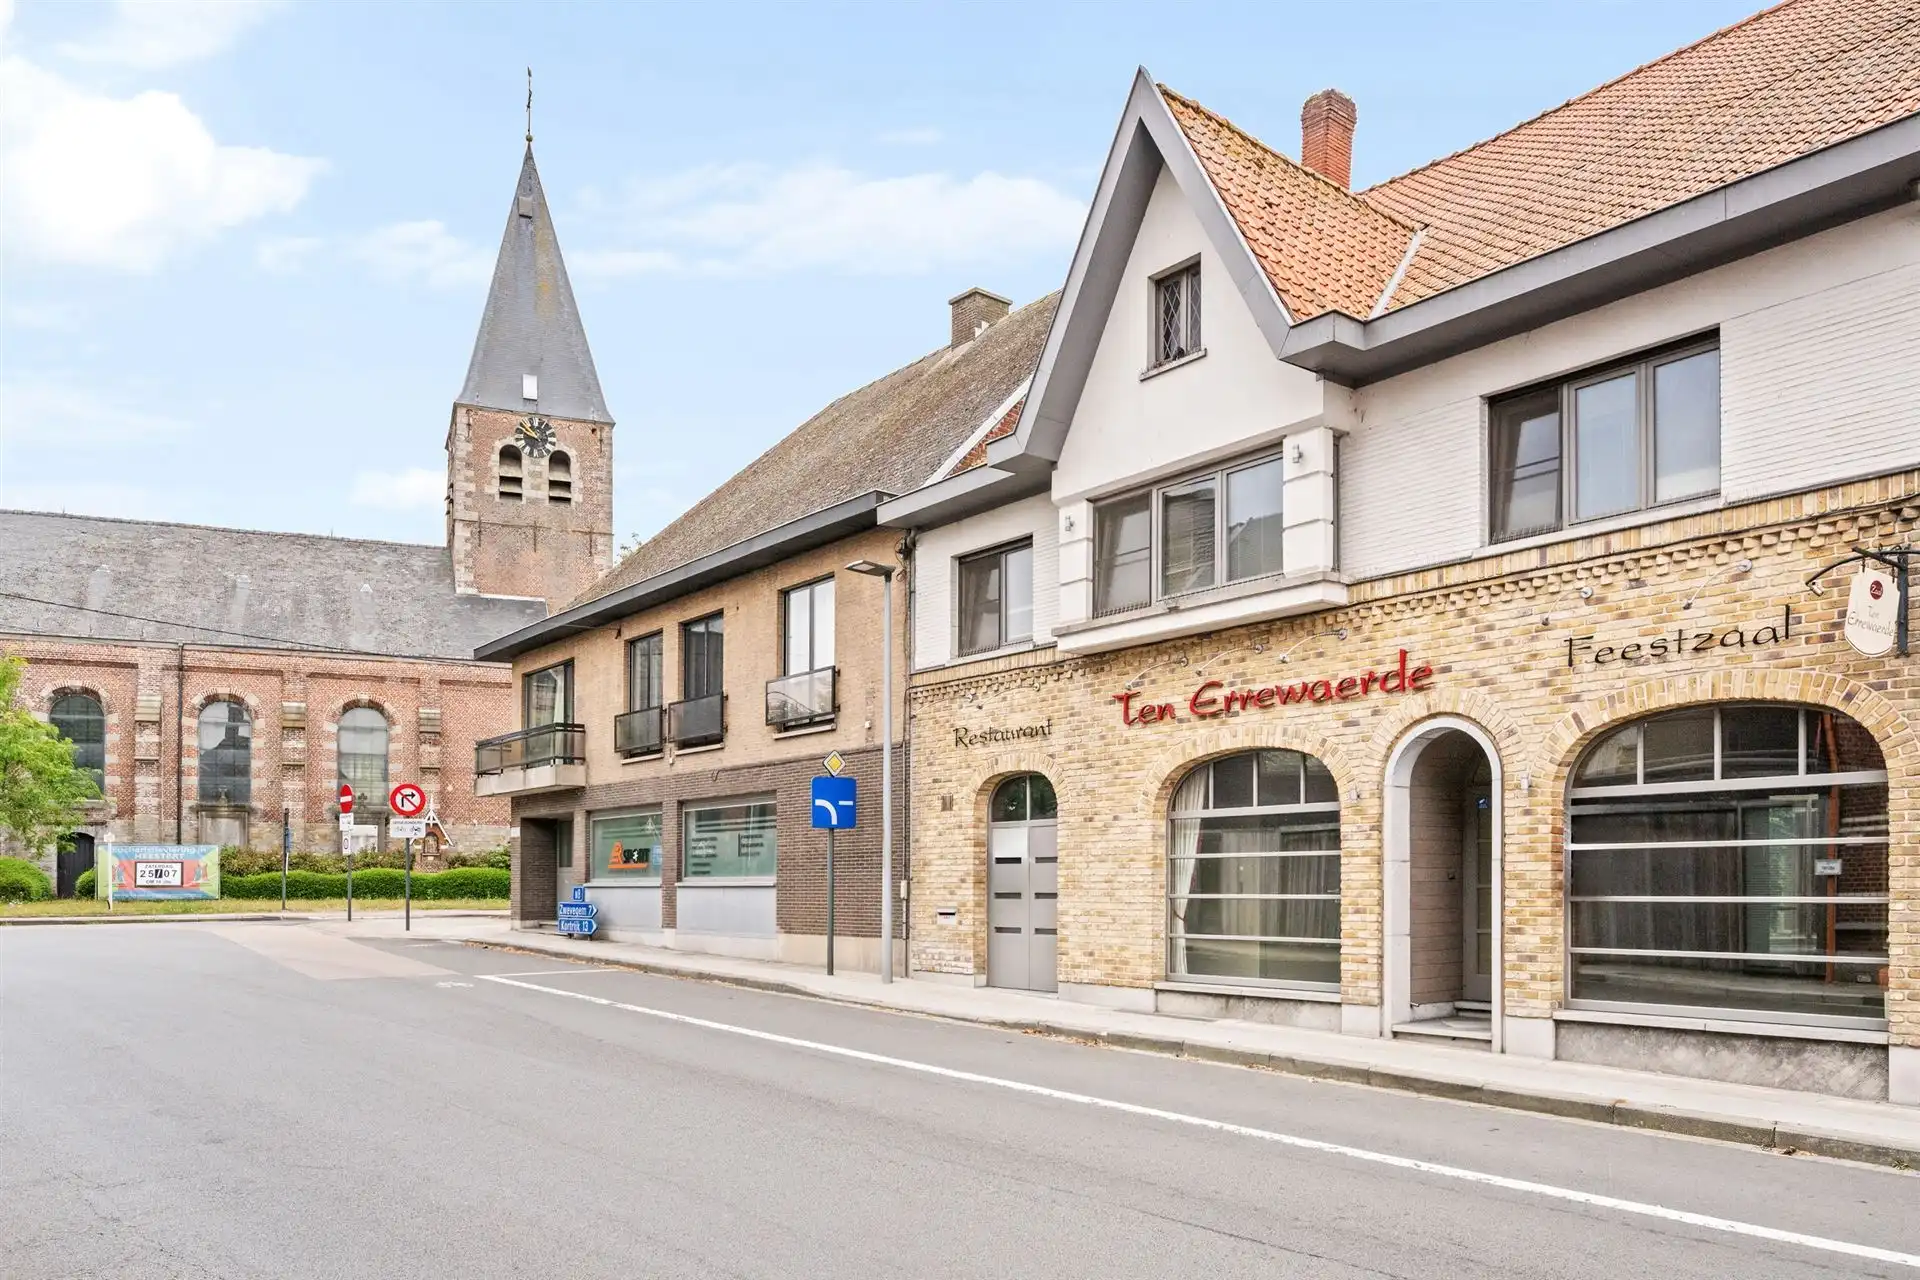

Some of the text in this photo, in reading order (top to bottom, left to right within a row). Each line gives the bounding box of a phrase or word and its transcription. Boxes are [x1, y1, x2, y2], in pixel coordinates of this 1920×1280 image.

[1564, 604, 1791, 668] Feestzaal
[1112, 648, 1435, 727] Ten Errewaerde
[953, 718, 1053, 748] Restaurant
[560, 904, 592, 916] Zwevegem 7
[561, 920, 589, 932] Kortrijk 13
